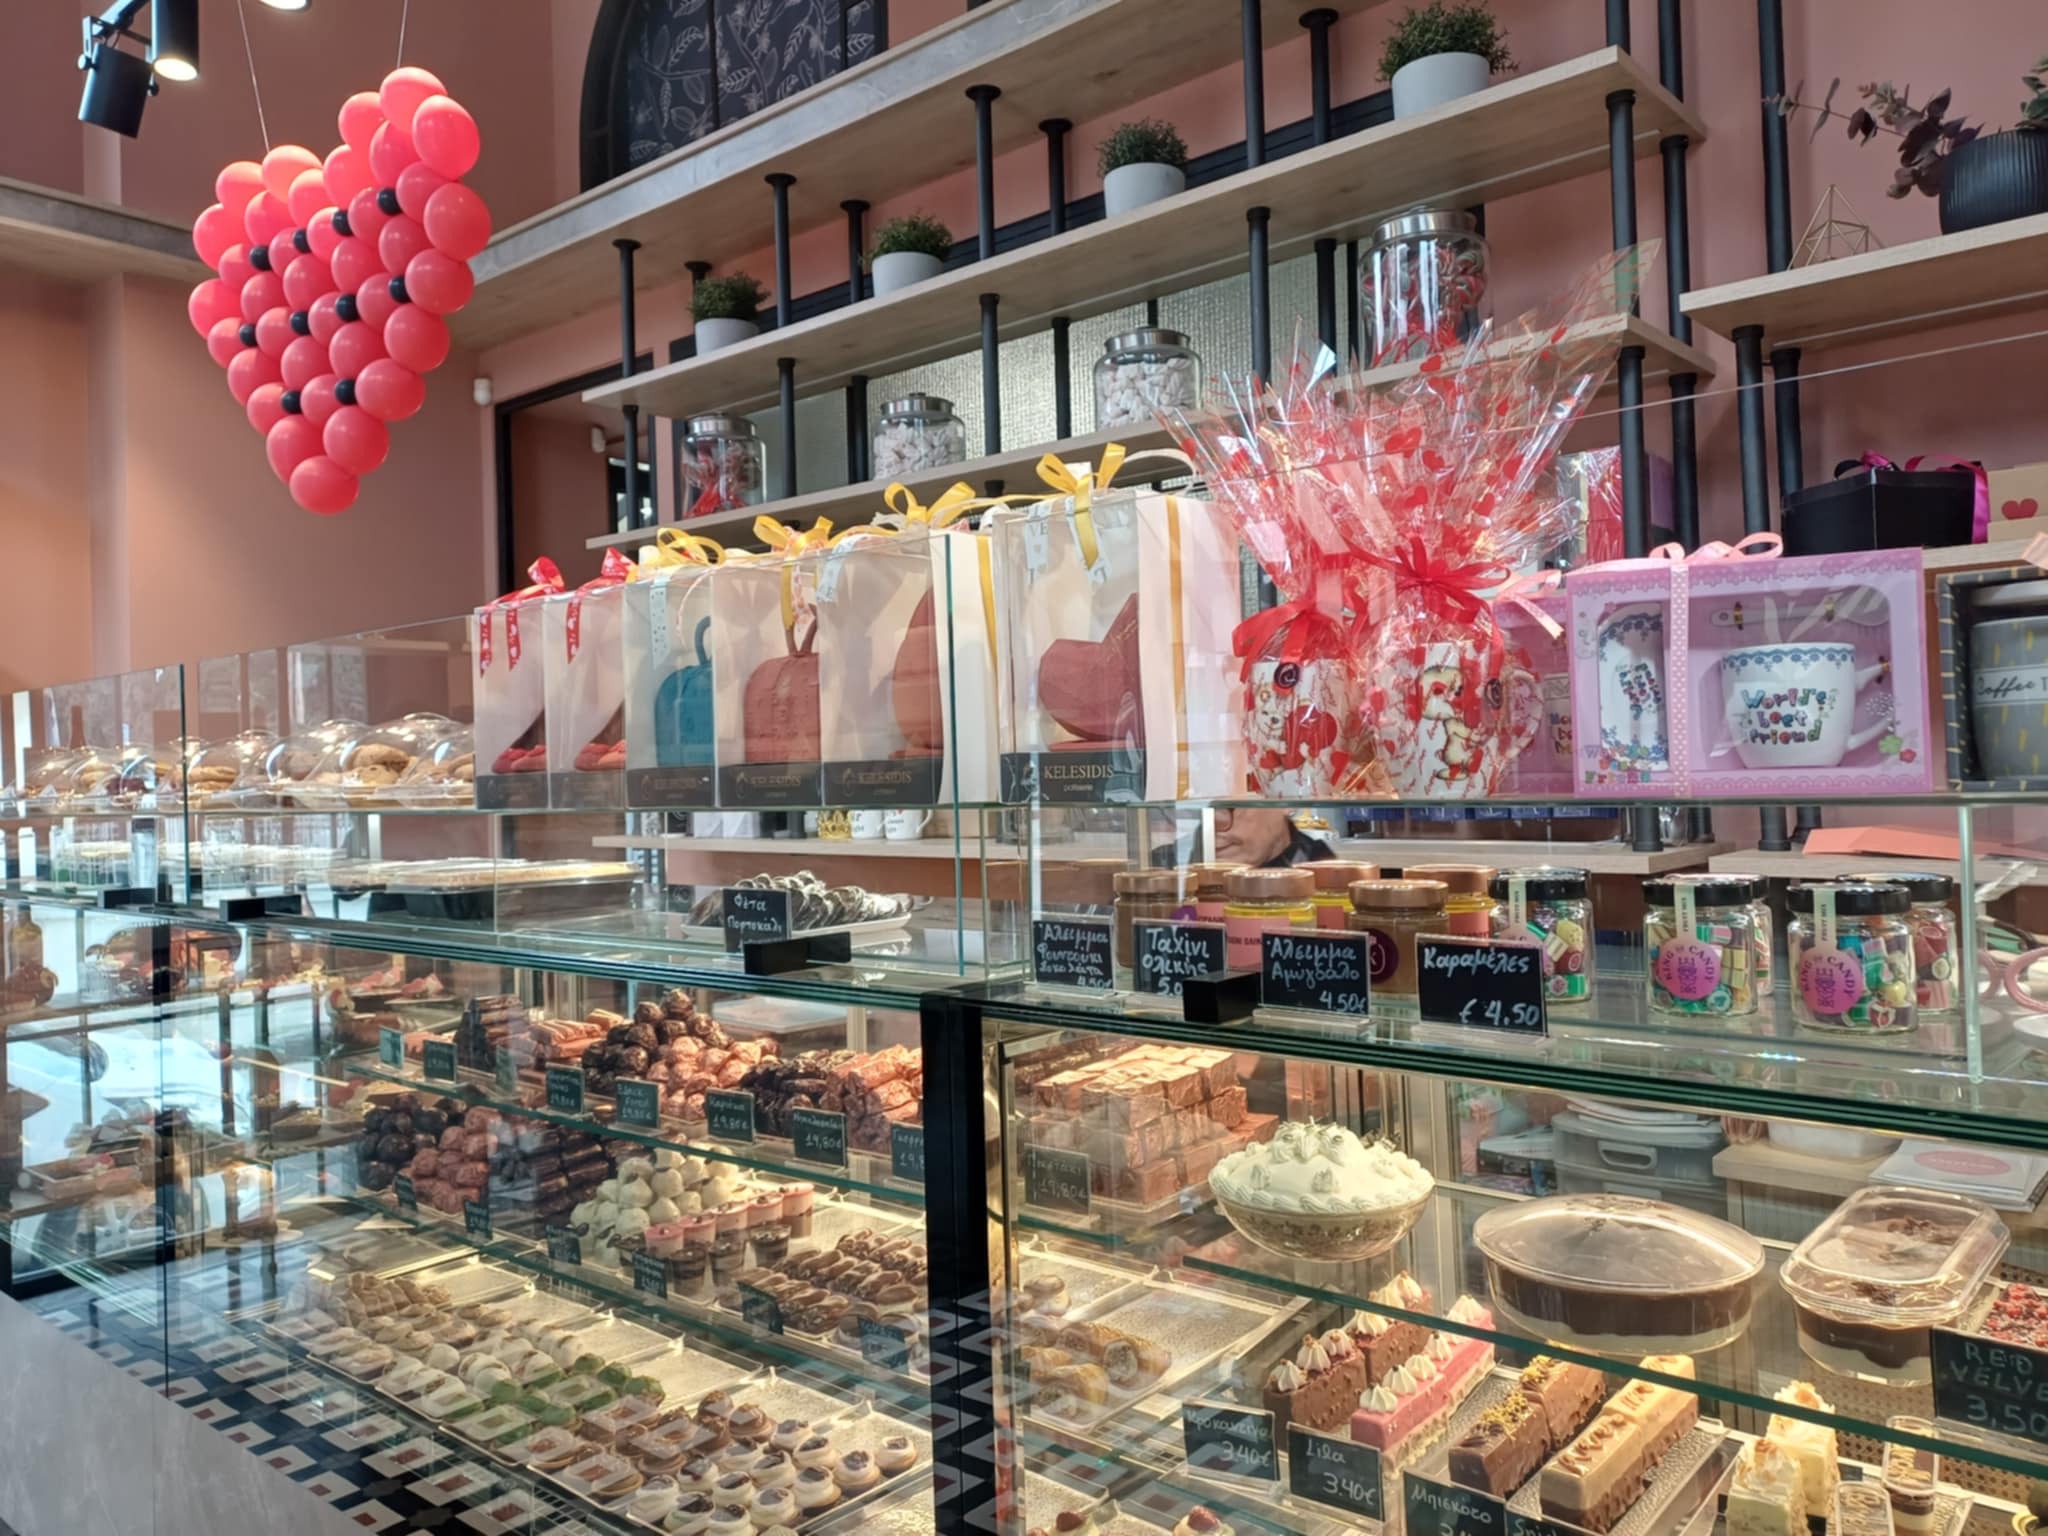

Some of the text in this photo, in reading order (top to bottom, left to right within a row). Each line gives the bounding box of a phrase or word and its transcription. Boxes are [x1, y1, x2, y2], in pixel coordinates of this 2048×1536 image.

[1741, 688, 1827, 710] World's
[1977, 676, 2035, 698] Coffee
[1749, 719, 1823, 744] friend
[1757, 710, 1808, 728] best
[1043, 764, 1114, 779] KELESIDIS
[1424, 946, 1530, 978] Καραμέλες
[1688, 945, 1715, 983] CANDY
[1827, 956, 1855, 998] CANDY
[1484, 999, 1540, 1026] 4.50
[1221, 1440, 1271, 1467] 3.40€
[1306, 1438, 1347, 1463] Lila
[1322, 1471, 1377, 1504] 3.40€
